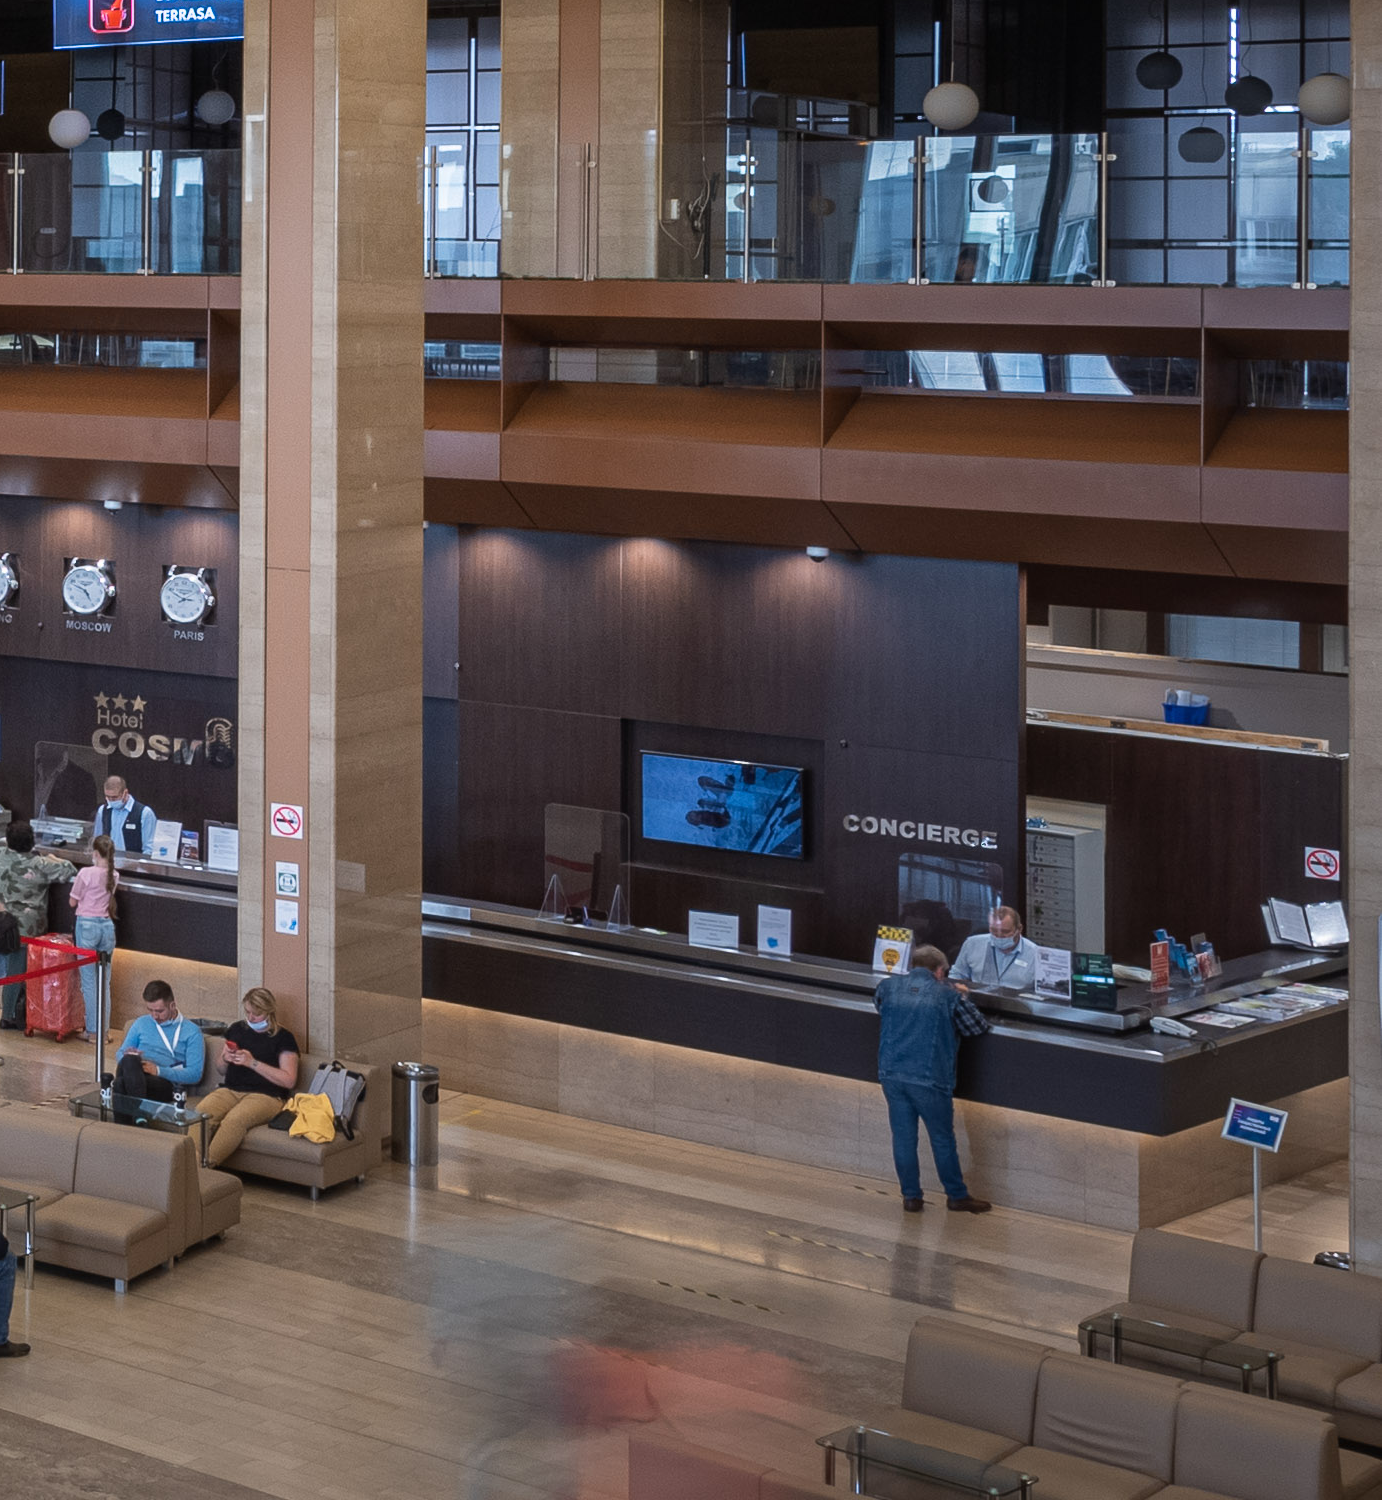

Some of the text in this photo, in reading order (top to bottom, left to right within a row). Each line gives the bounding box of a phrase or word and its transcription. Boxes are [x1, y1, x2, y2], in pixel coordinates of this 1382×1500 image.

[156, 7, 215, 23] TERRASA
[65, 619, 113, 633] MOSCOW
[173, 629, 205, 641] PARIS
[97, 709, 143, 729] Hotel
[842, 814, 998, 849] CONCIERGE
